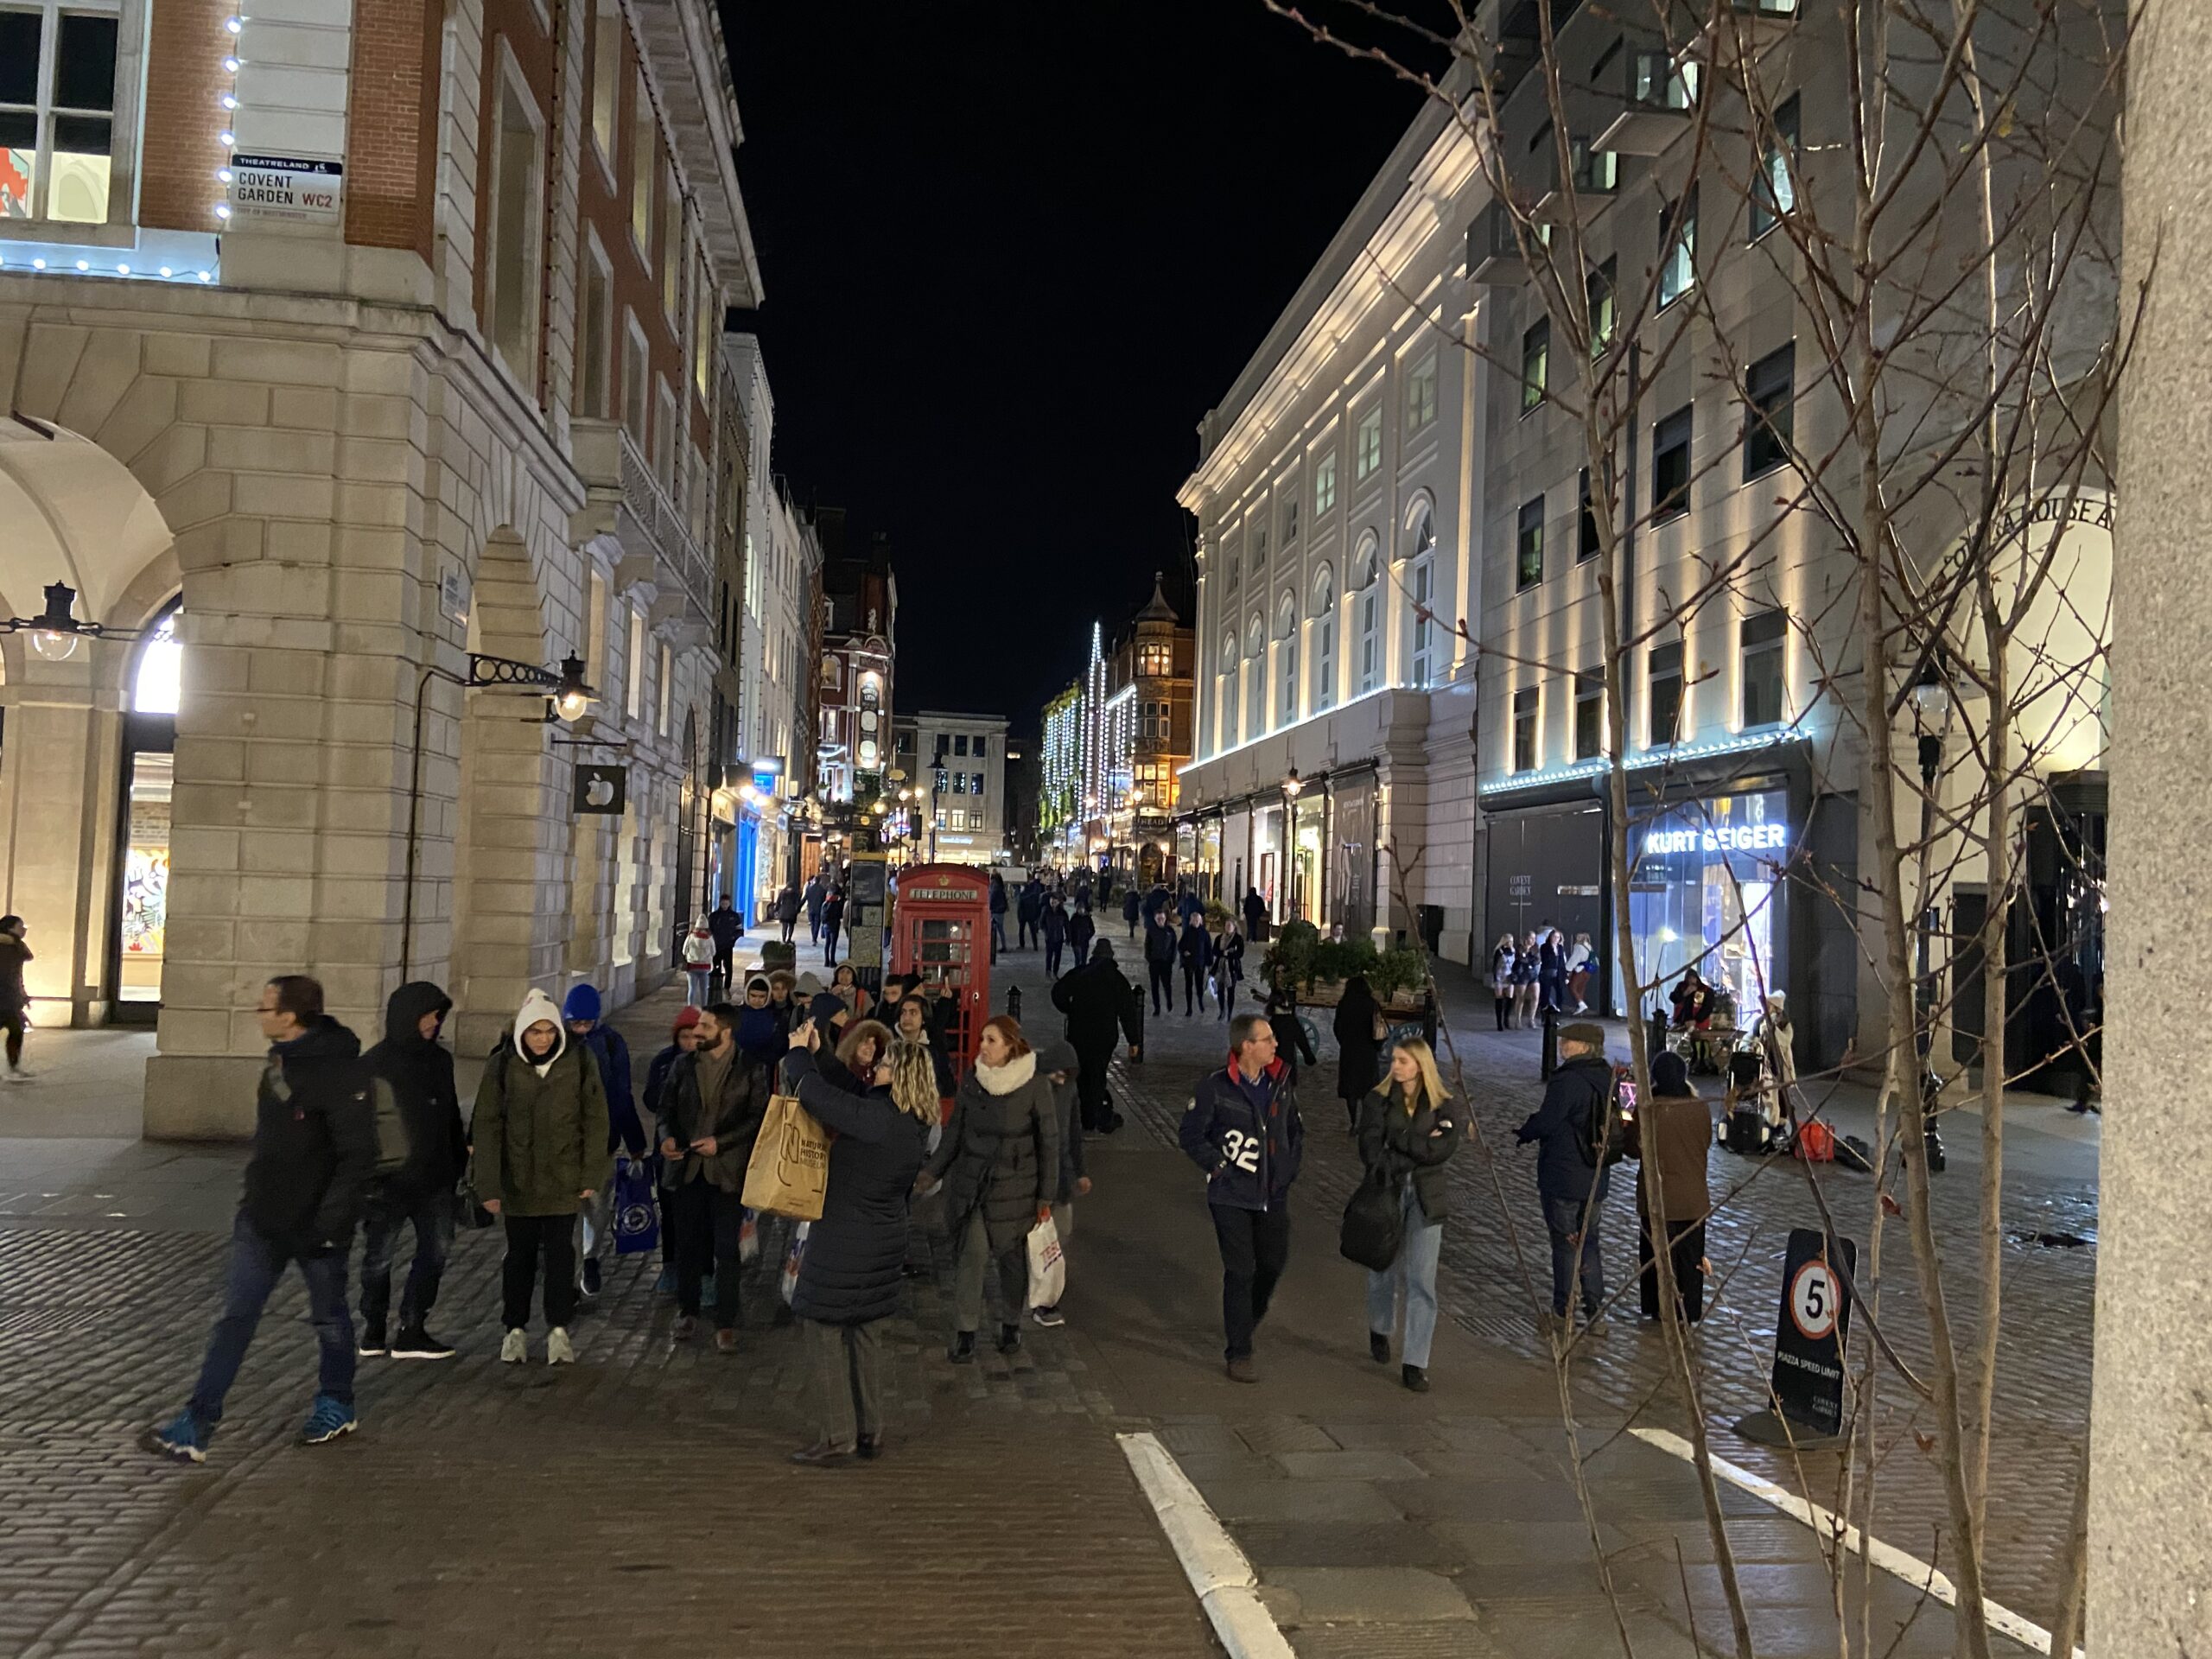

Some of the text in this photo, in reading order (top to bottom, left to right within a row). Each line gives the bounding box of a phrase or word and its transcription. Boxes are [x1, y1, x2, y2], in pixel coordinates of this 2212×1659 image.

[240, 157, 309, 169] THEATRELAND
[238, 172, 293, 188] COVENT
[238, 188, 333, 208] GARDEN WC2
[1647, 823, 1786, 855] KURT GEIGER
[913, 890, 976, 900] TELEPHONE
[1222, 1129, 1260, 1173] 32
[1805, 1279, 1825, 1319] 5
[1777, 1351, 1840, 1380] PIAZZA SPEED LIMIT
